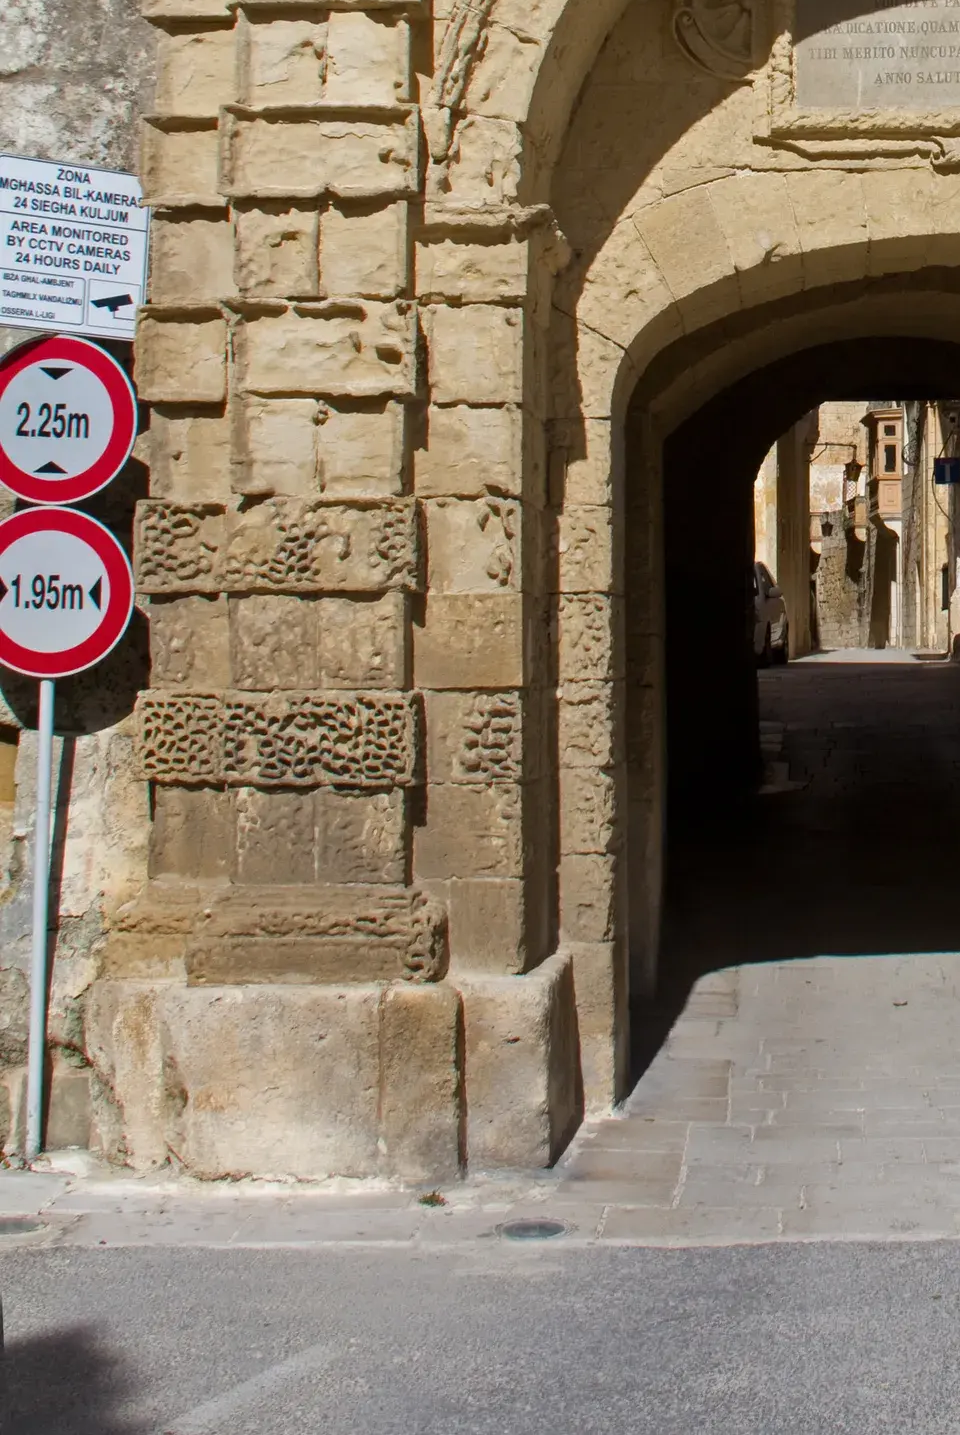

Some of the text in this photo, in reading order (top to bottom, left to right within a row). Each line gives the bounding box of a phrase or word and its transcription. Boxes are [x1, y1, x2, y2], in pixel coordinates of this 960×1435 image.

[808, 47, 836, 60] TIBI
[843, 46, 895, 60] MERITO
[874, 72, 912, 85] ANNO
[13, 196, 28, 209] 24
[80, 205, 129, 223] KULJUM
[10, 220, 129, 246] AREA MONITORED
[6, 235, 131, 262] BY CCTV CAMERAS
[15, 252, 121, 275] 24 HOURS DAILY
[15, 401, 90, 439] 2.25m
[11, 574, 84, 610] 1.95m
